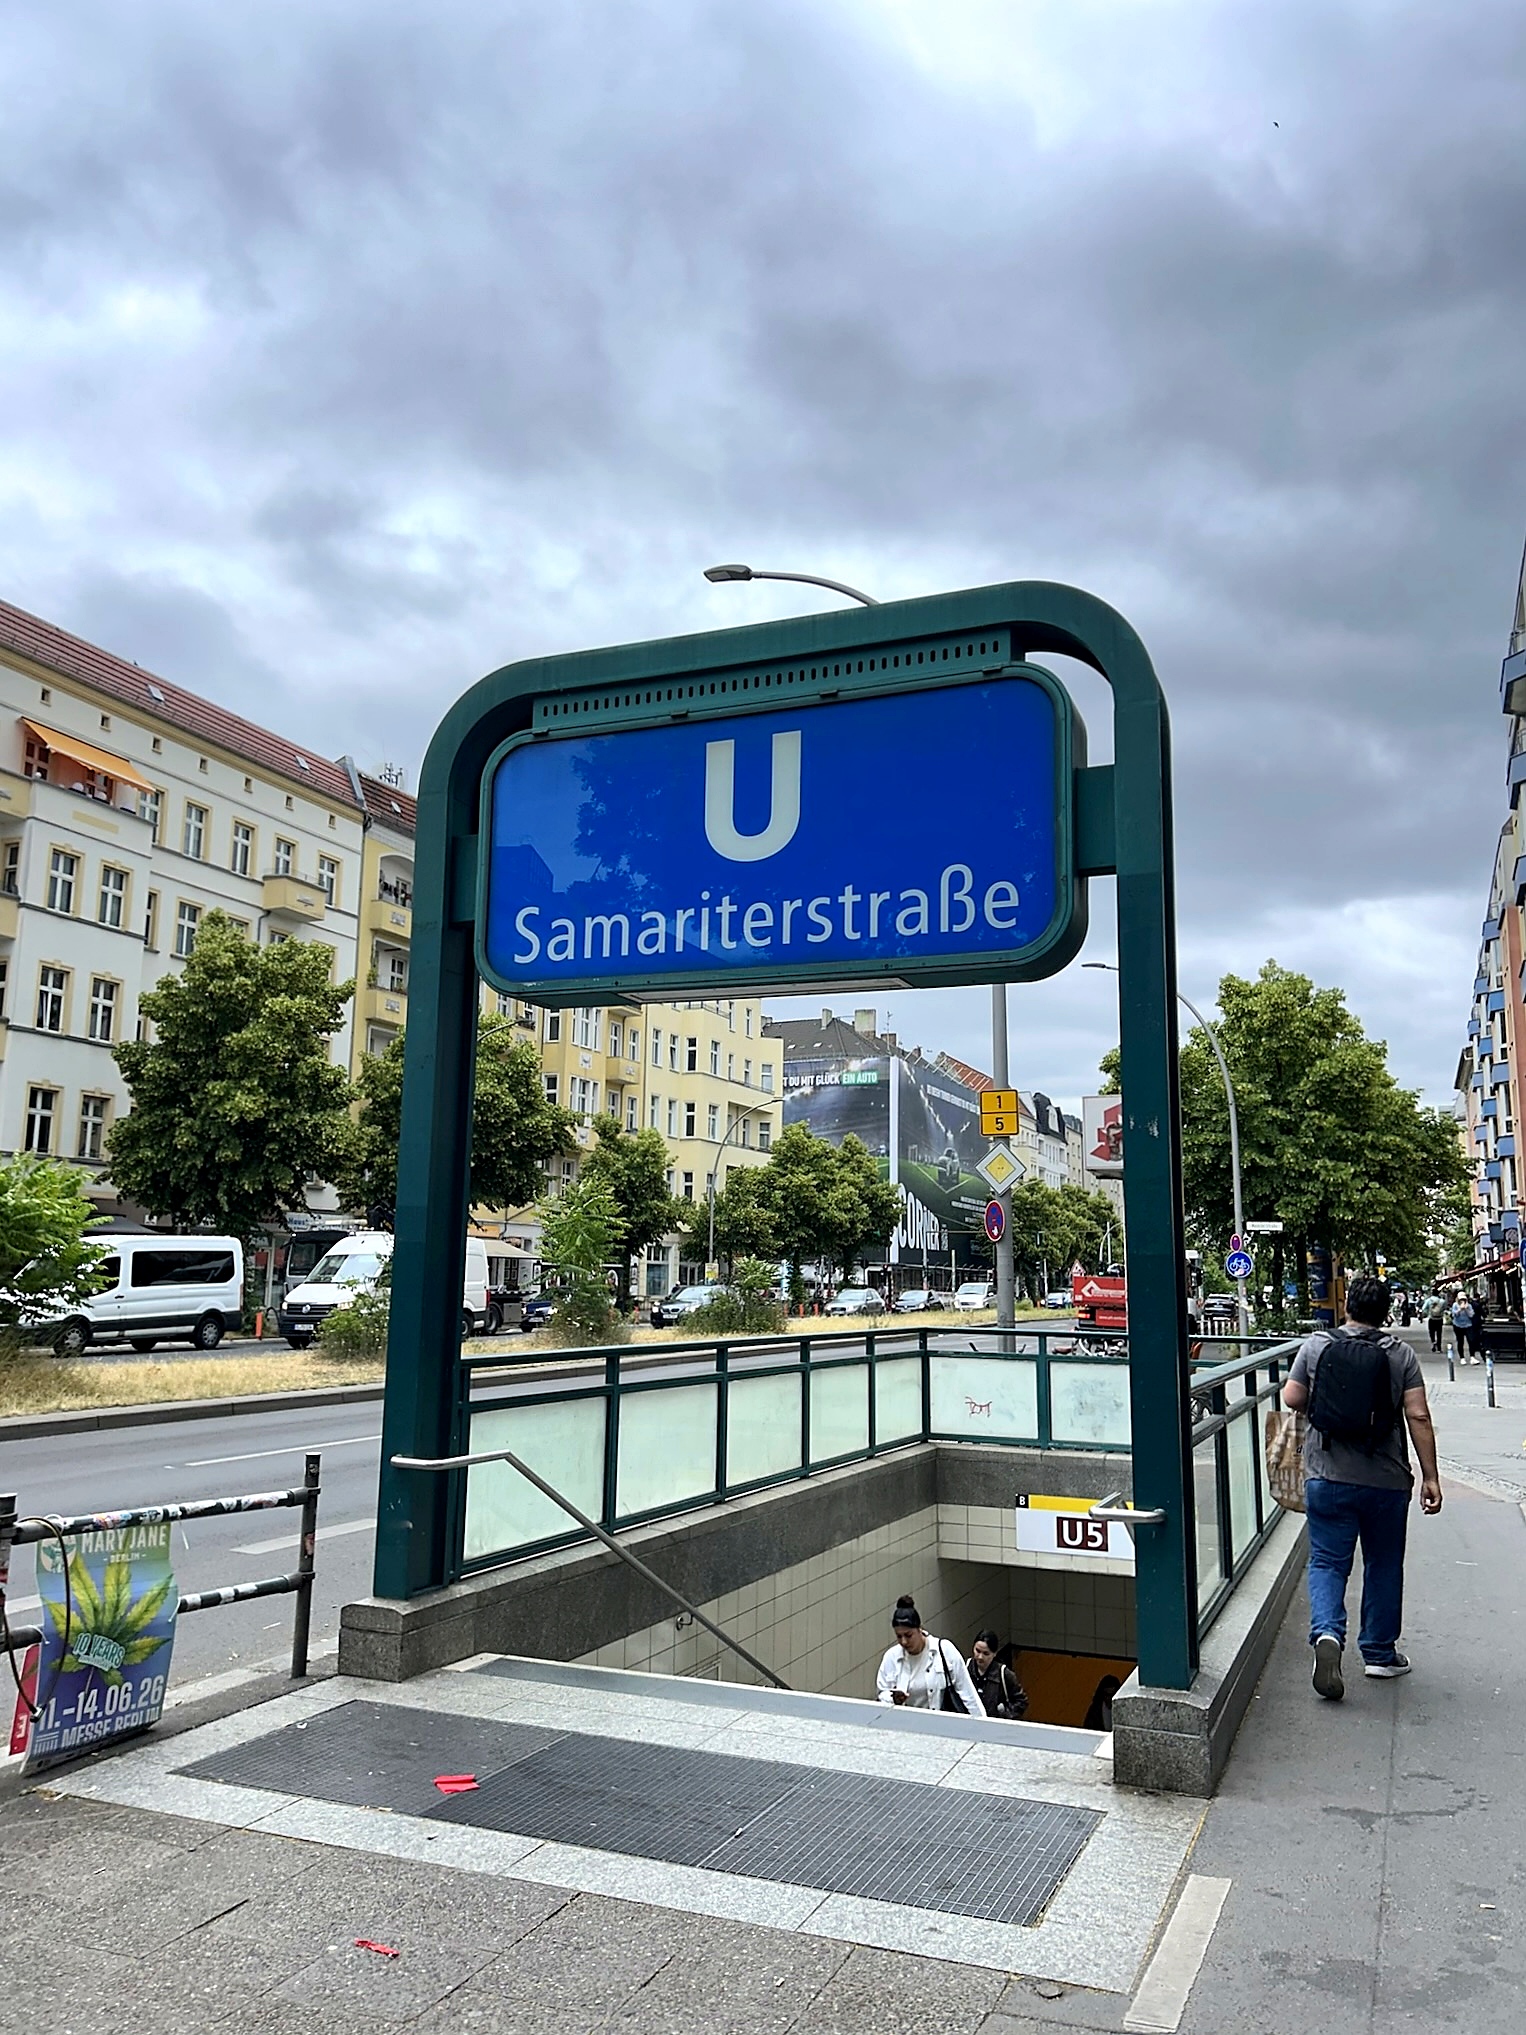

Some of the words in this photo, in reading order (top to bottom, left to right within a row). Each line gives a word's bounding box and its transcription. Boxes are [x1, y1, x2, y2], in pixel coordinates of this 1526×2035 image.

[704, 730, 802, 862] U
[512, 863, 1020, 965] Samariterstraße
[789, 1076, 799, 1087] DU
[801, 1075, 815, 1086] MIT
[815, 1072, 840, 1086] GLÜCK
[842, 1073, 855, 1085] EIN
[856, 1071, 878, 1084] AUTO
[996, 1095, 1002, 1109] 1
[995, 1117, 1004, 1131] 5
[1019, 1495, 1026, 1506] B
[81, 1528, 127, 1553] MARY
[129, 1525, 167, 1549] JANE
[1062, 1519, 1104, 1548] U5
[73, 1632, 91, 1655] 10
[90, 1634, 125, 1668] YEARS
